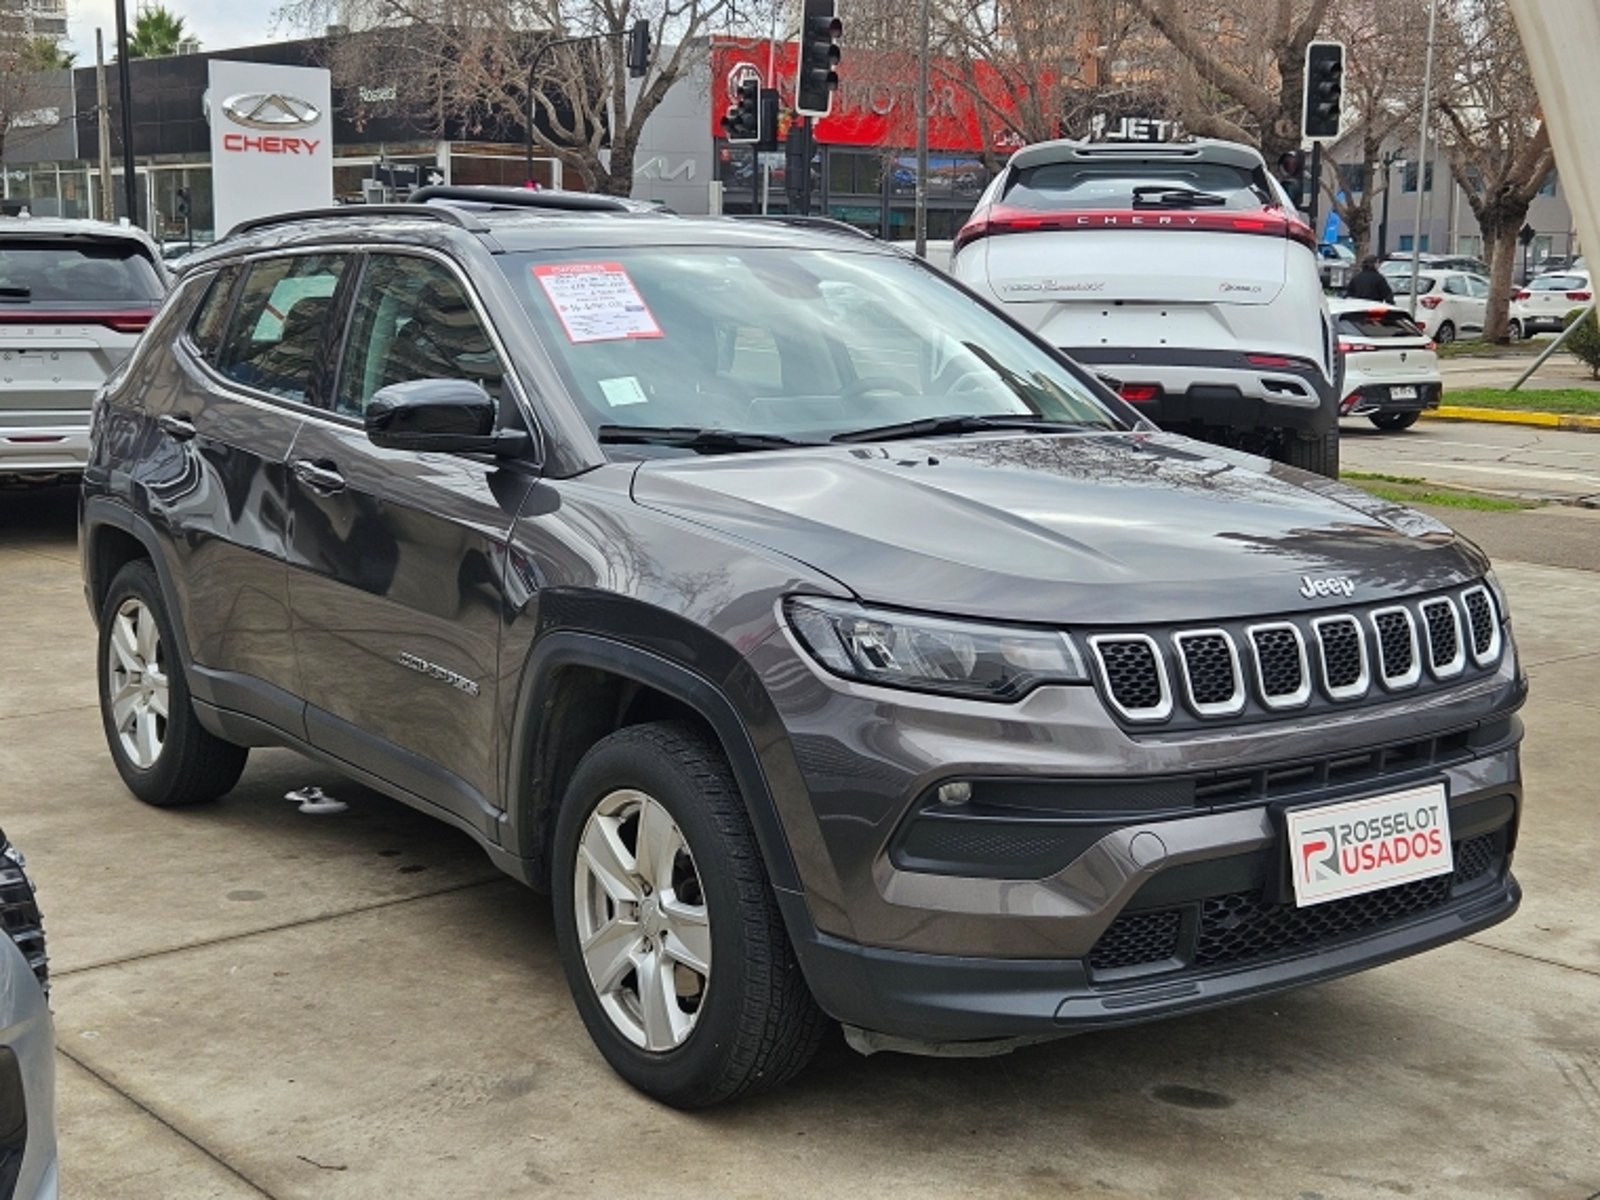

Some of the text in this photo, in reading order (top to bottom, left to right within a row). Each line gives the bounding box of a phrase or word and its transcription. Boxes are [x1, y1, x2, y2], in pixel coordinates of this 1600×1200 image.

[223, 134, 321, 156] CHERY
[1076, 215, 1199, 225] CHERY
[1300, 573, 1355, 600] Jeep
[1339, 805, 1440, 846] ROSSELOT
[1343, 828, 1443, 875] USADOS
